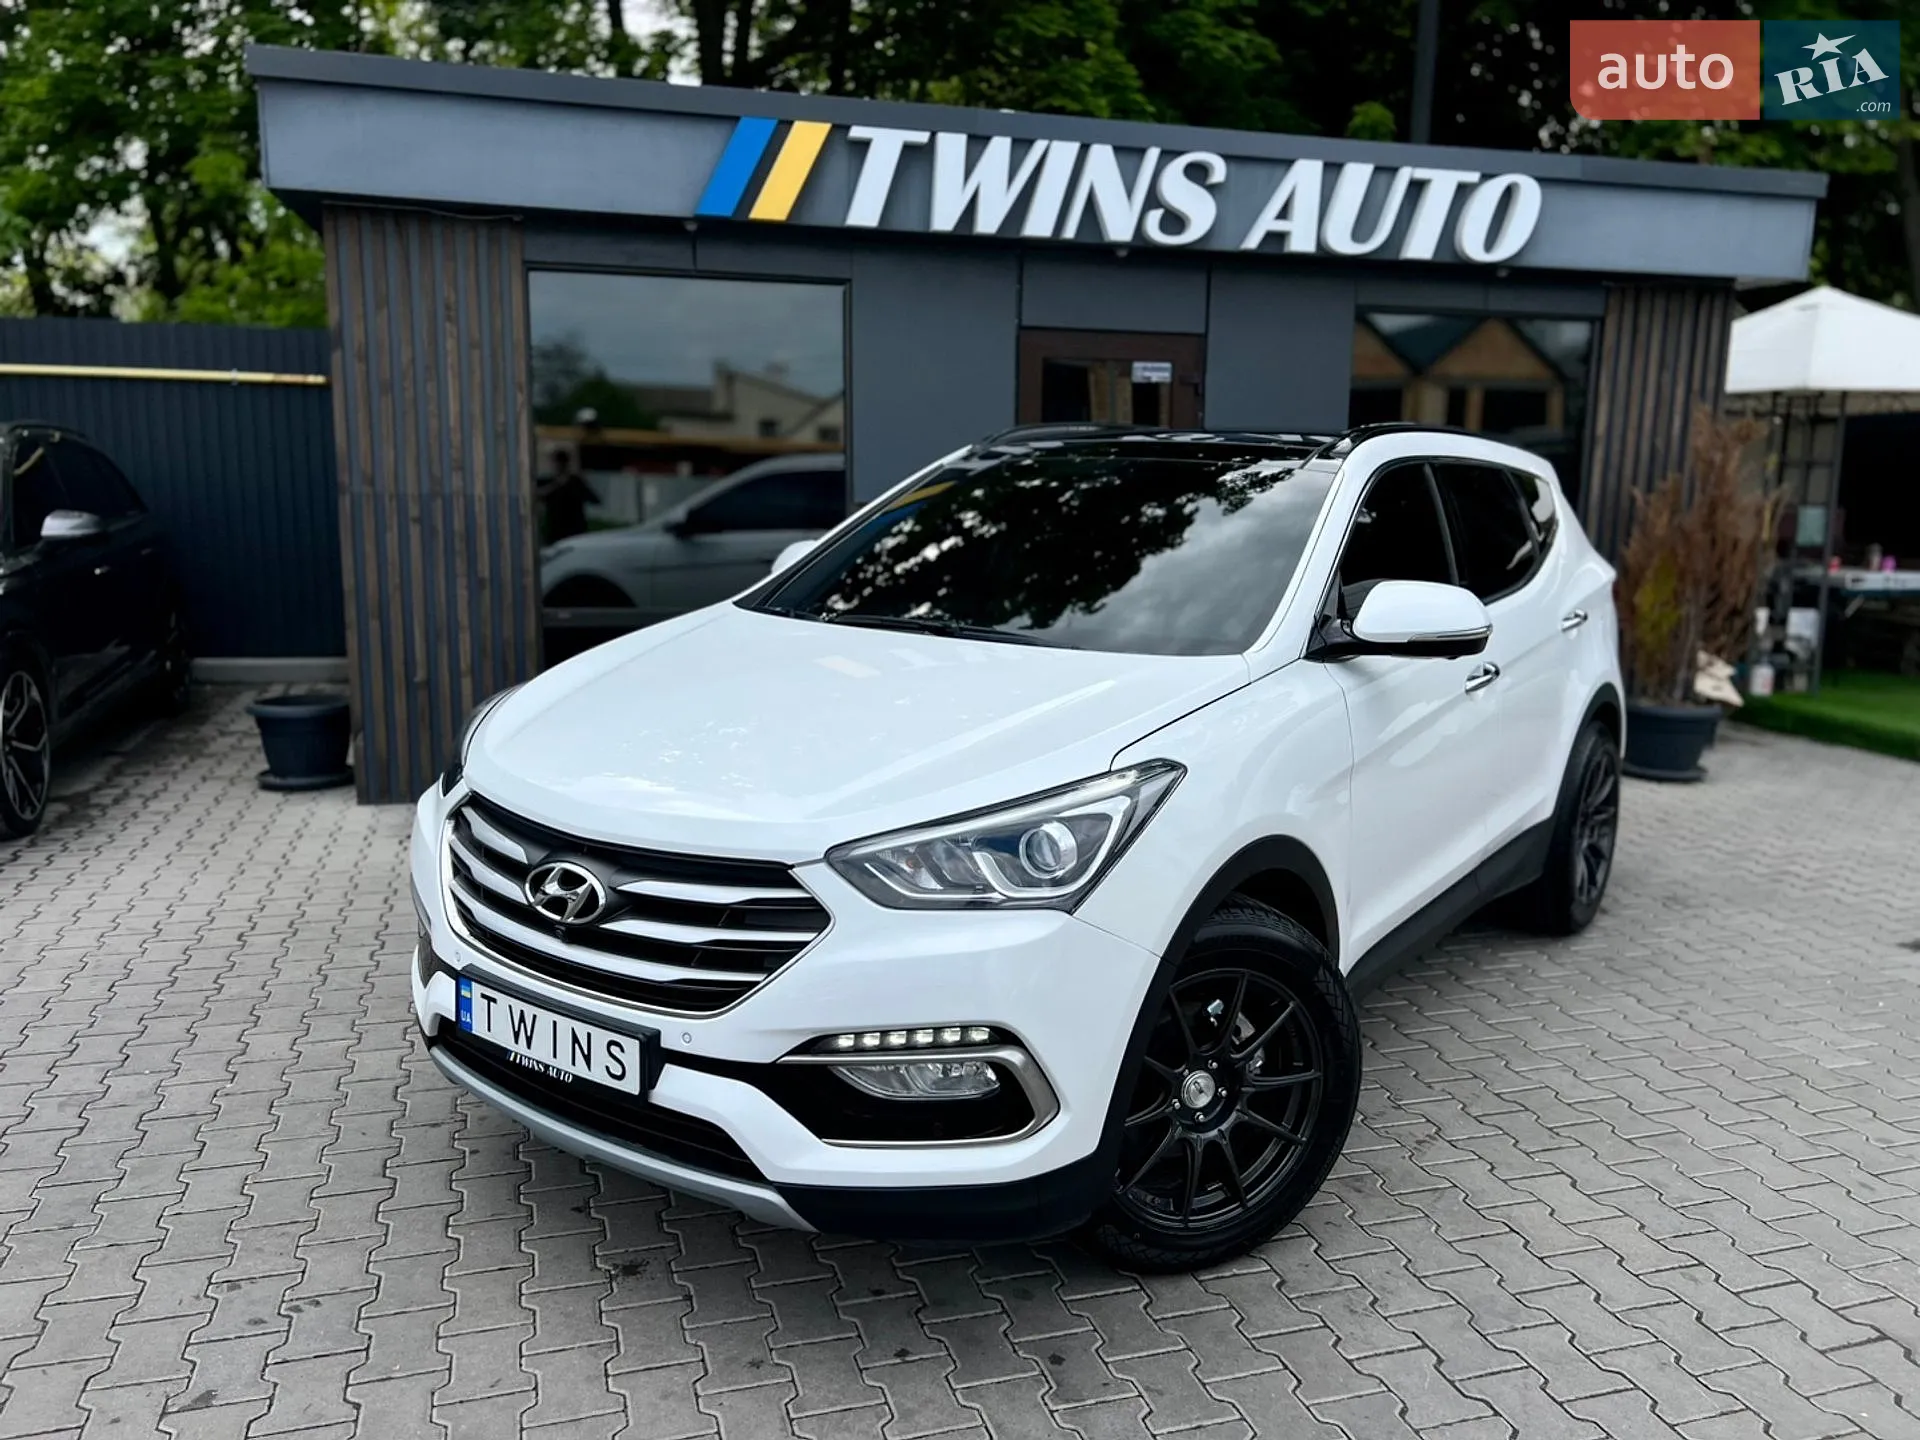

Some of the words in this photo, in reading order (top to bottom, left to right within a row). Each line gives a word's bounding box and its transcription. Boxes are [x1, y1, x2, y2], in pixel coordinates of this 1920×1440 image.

[845, 125, 1227, 247] TWINS
[1240, 157, 1543, 264] AUTO
[460, 1010, 472, 1024] UA
[480, 992, 627, 1082] TWINS
